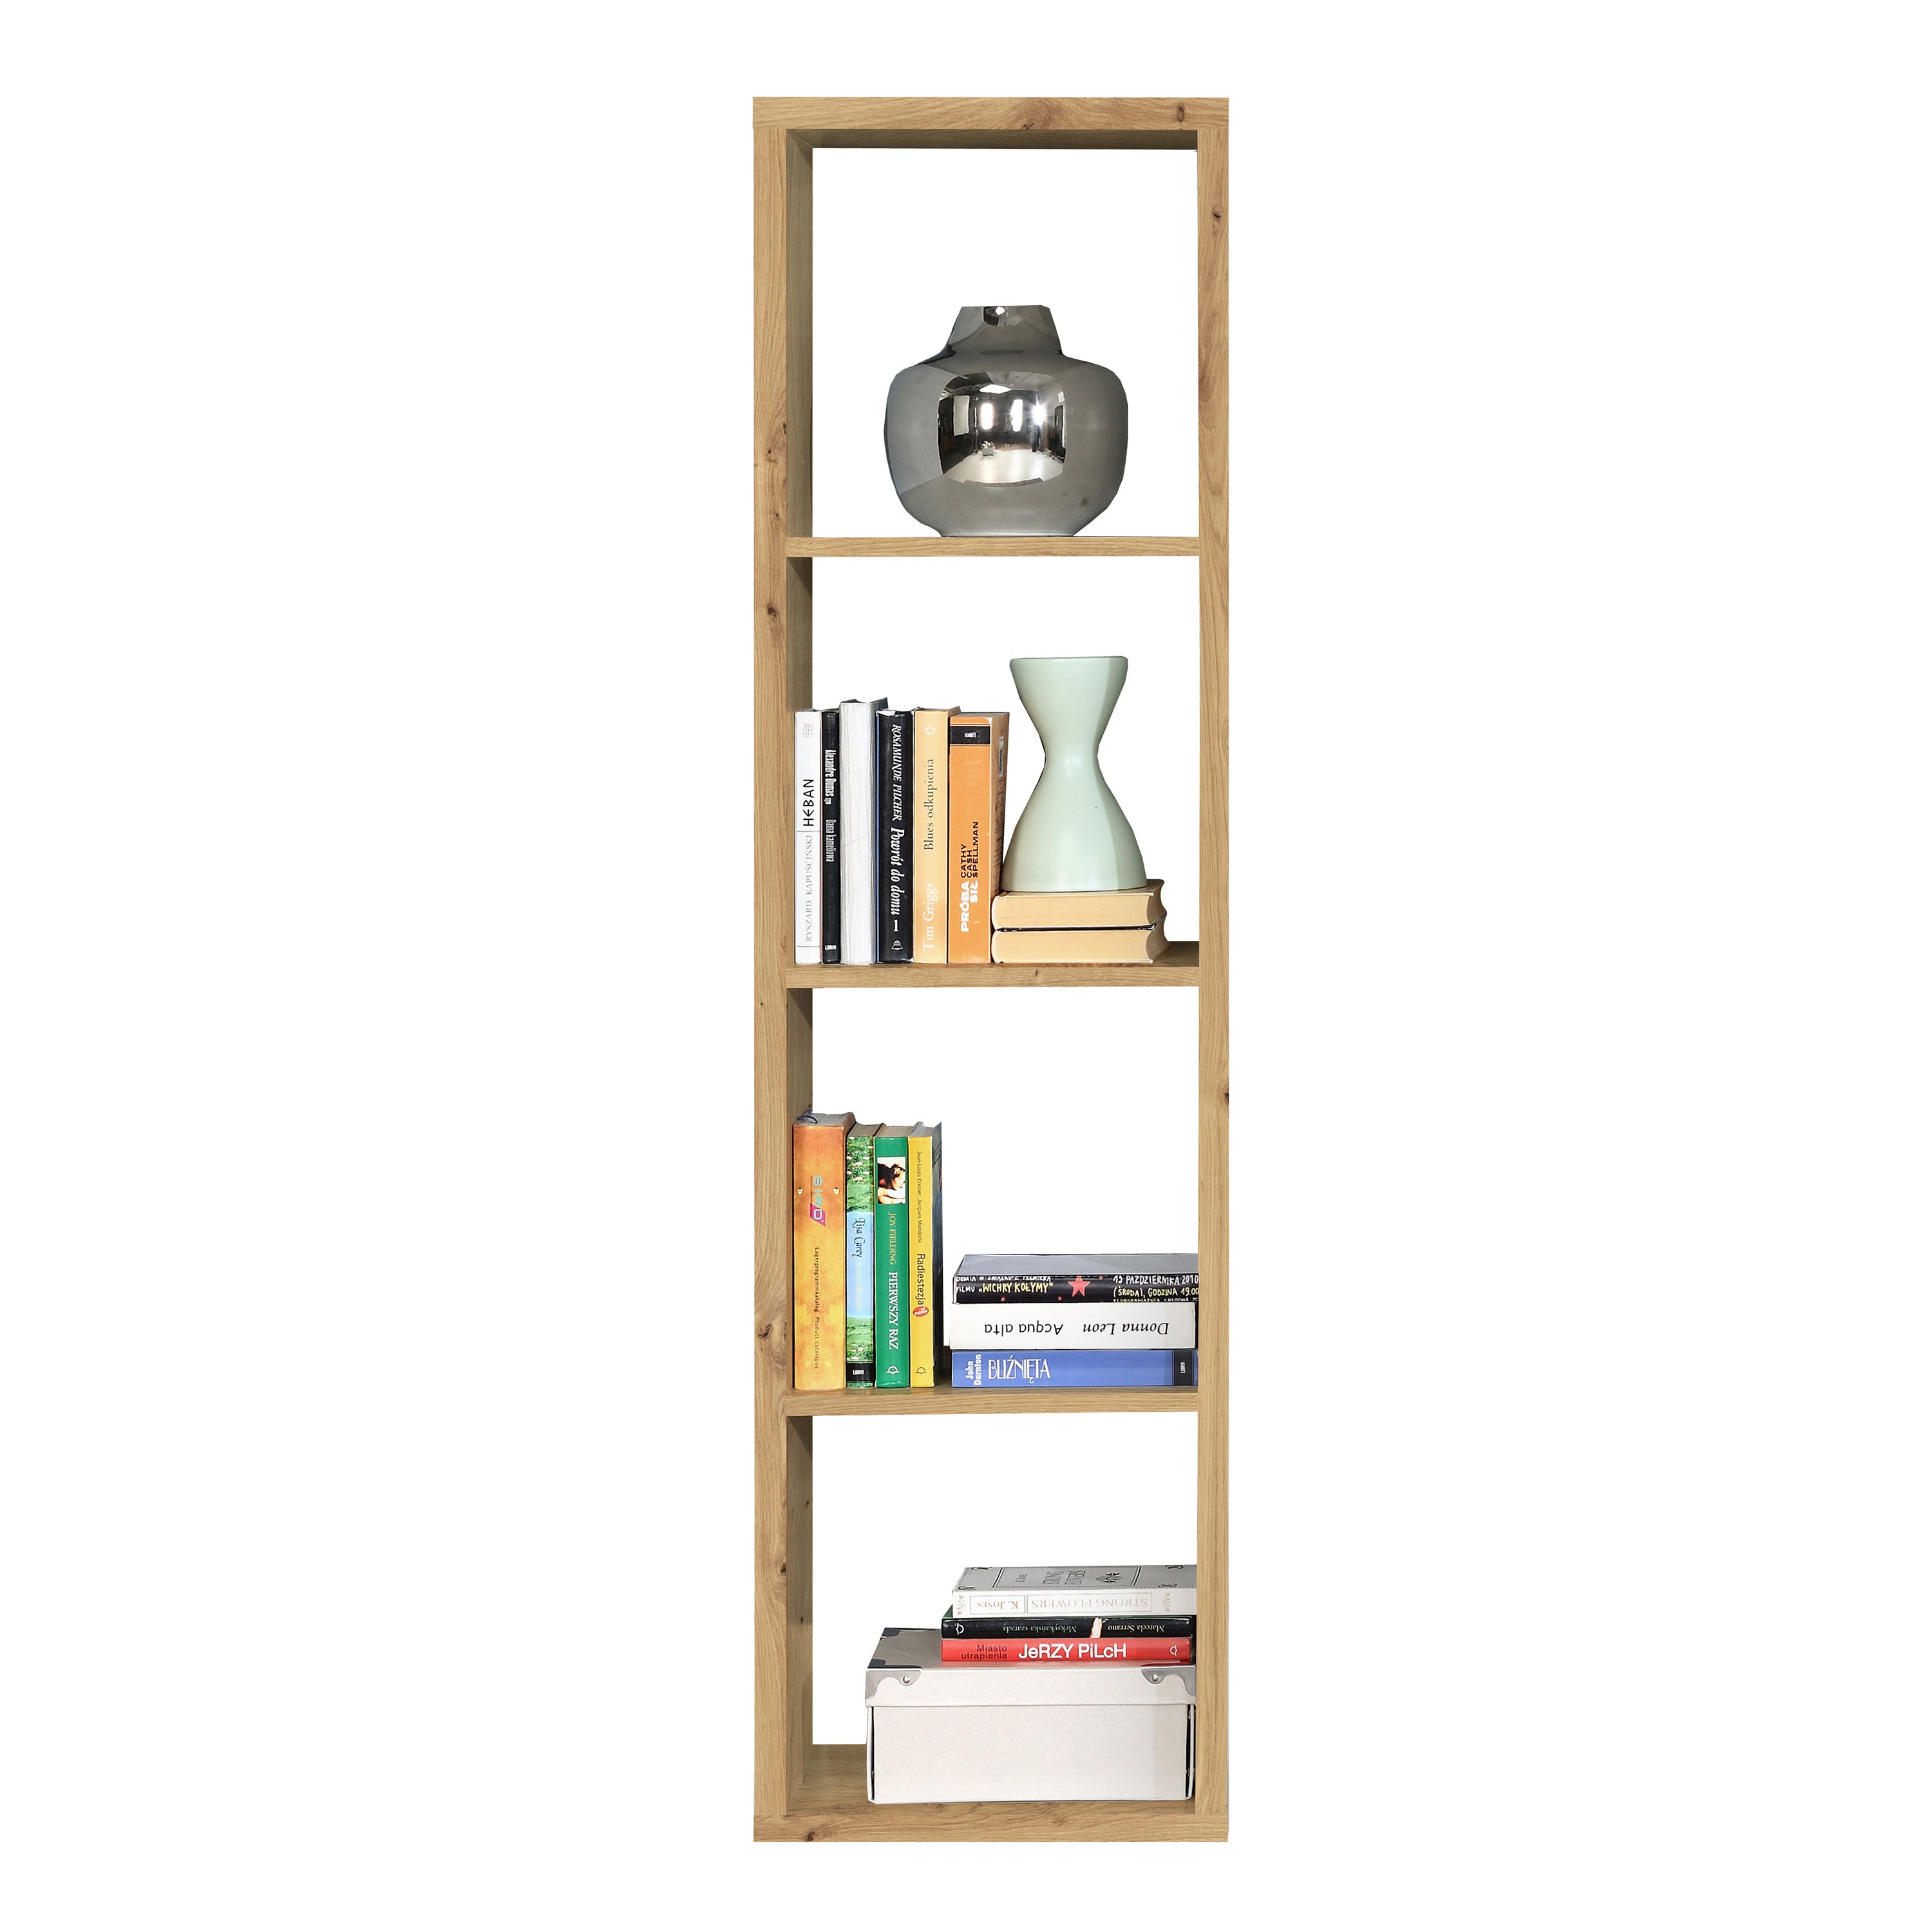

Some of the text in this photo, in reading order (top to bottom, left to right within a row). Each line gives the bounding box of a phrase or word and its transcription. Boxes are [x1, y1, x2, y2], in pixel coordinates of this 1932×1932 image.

[825, 750, 837, 778] Alexandre
[891, 724, 903, 822] ROSAMUNDE PILCHER
[825, 779, 837, 797] Dumas
[802, 779, 815, 827] HEBAN
[923, 758, 937, 851] Blues odkupienia
[825, 819, 837, 862] Dama kameliowa
[804, 835, 813, 895] KAPUŚCIŃSKI
[891, 828, 905, 915] Powrót do domu
[970, 880, 978, 904] SIŁ
[922, 882, 938, 952] Tim Griggs
[959, 880, 970, 933] PRÓBA
[813, 1175, 824, 1221] SIRO
[852, 1217, 866, 1235] Lisa
[915, 1253, 926, 1305] Radiestezja
[1182, 1275, 1198, 1284] 2010
[1148, 1287, 1178, 1297] GODZINA
[889, 1271, 899, 1350] PIERWSZY RAZ
[984, 1323, 1064, 1337] Acqua alta
[1083, 1322, 1170, 1336] Donna Leon
[965, 1360, 974, 1379] John
[974, 1354, 982, 1385] Darnton
[988, 1354, 1052, 1384] BLIŹNIĘTA
[1008, 1600, 1019, 1609] K.
[1032, 1597, 1148, 1609] STRONG FLOWERS
[1002, 1624, 1077, 1633] Meksykańska szarada
[1136, 1624, 1165, 1633] Marcela
[961, 1651, 1009, 1661] utrapienia
[976, 1644, 1008, 1653] Miasto
[1018, 1643, 1127, 1660] JeRZY PiLcH
